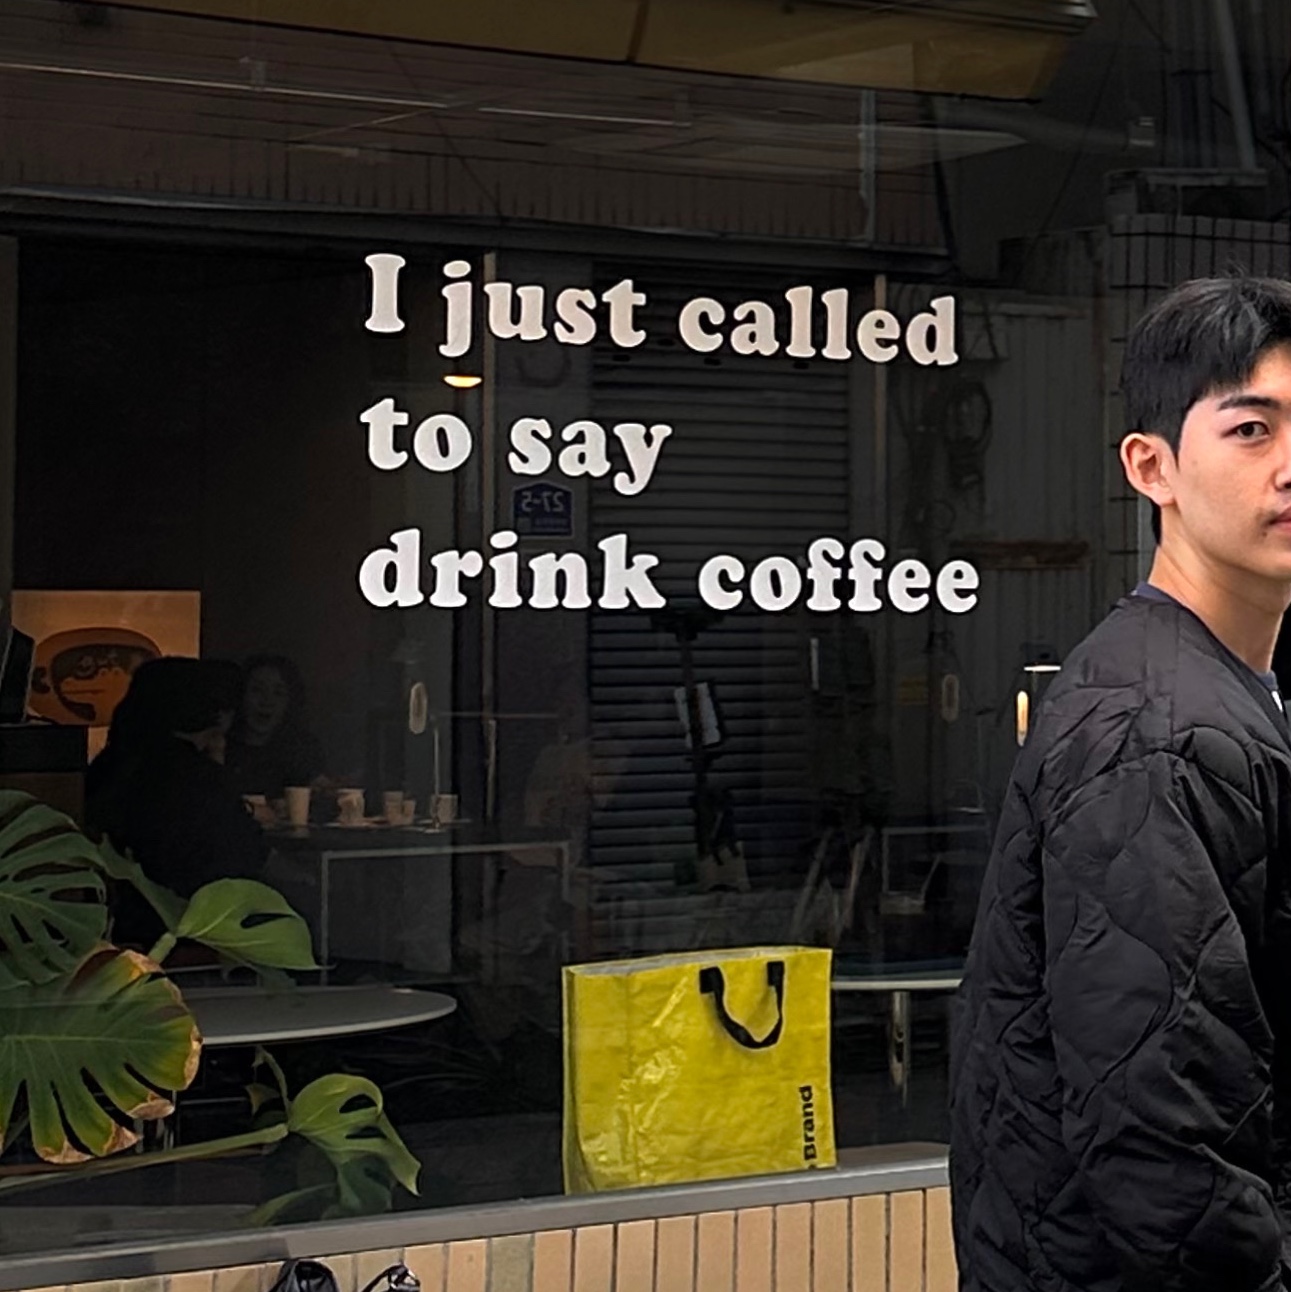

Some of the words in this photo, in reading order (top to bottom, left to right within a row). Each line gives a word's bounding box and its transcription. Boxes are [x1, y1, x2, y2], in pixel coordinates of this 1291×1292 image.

[365, 253, 406, 334] I
[439, 259, 647, 358] just
[678, 285, 960, 366] called
[360, 398, 473, 472] to
[508, 417, 673, 495] say
[359, 528, 667, 610] drink
[699, 537, 981, 613] coffee
[799, 1085, 817, 1161] Brand
